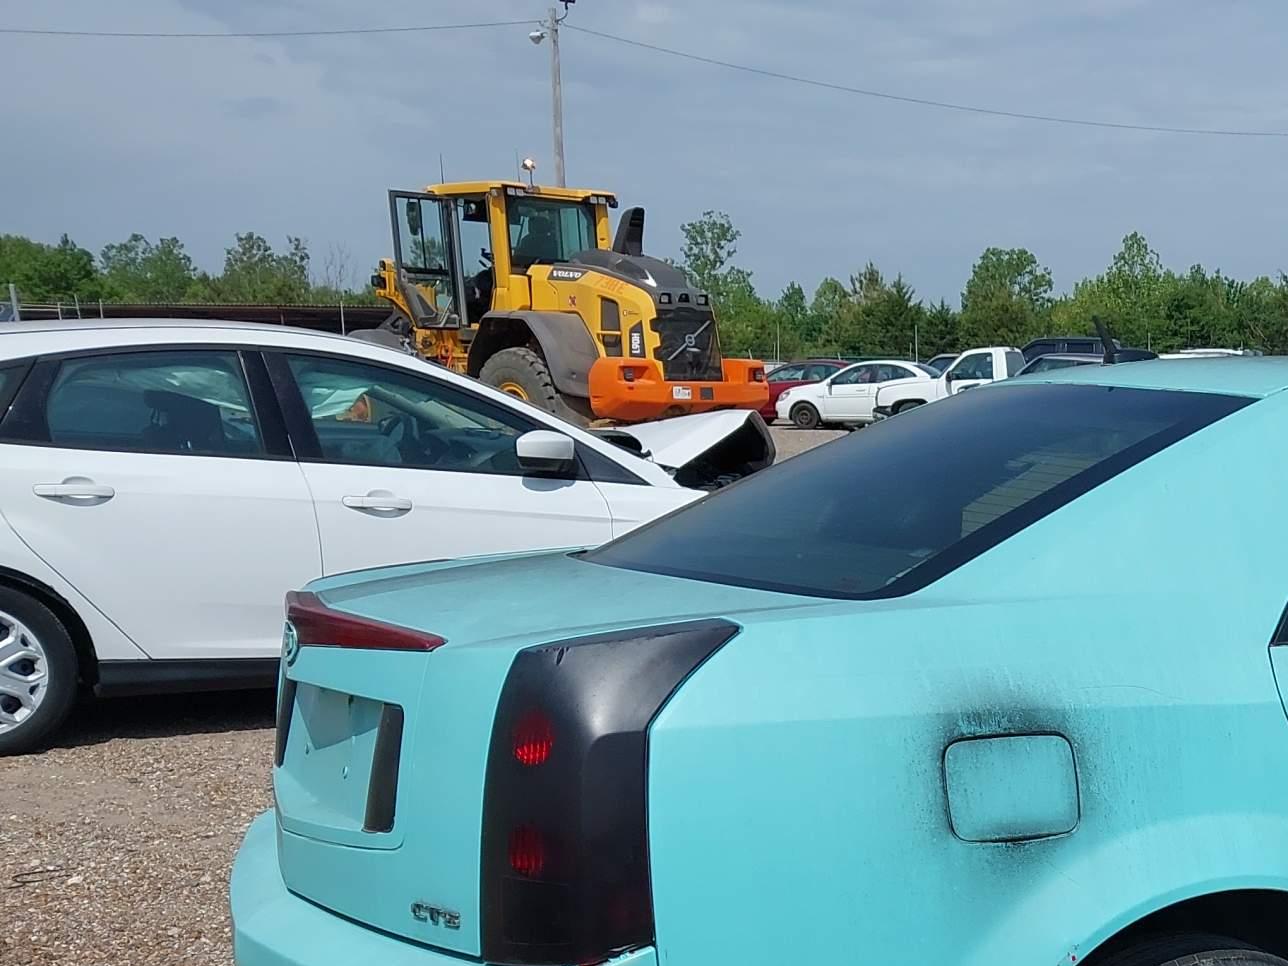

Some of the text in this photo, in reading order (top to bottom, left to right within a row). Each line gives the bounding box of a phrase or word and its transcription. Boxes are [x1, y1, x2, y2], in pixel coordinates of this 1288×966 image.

[552, 270, 582, 279] VOLVO
[631, 332, 641, 354] L90H
[410, 902, 461, 930] CTS
